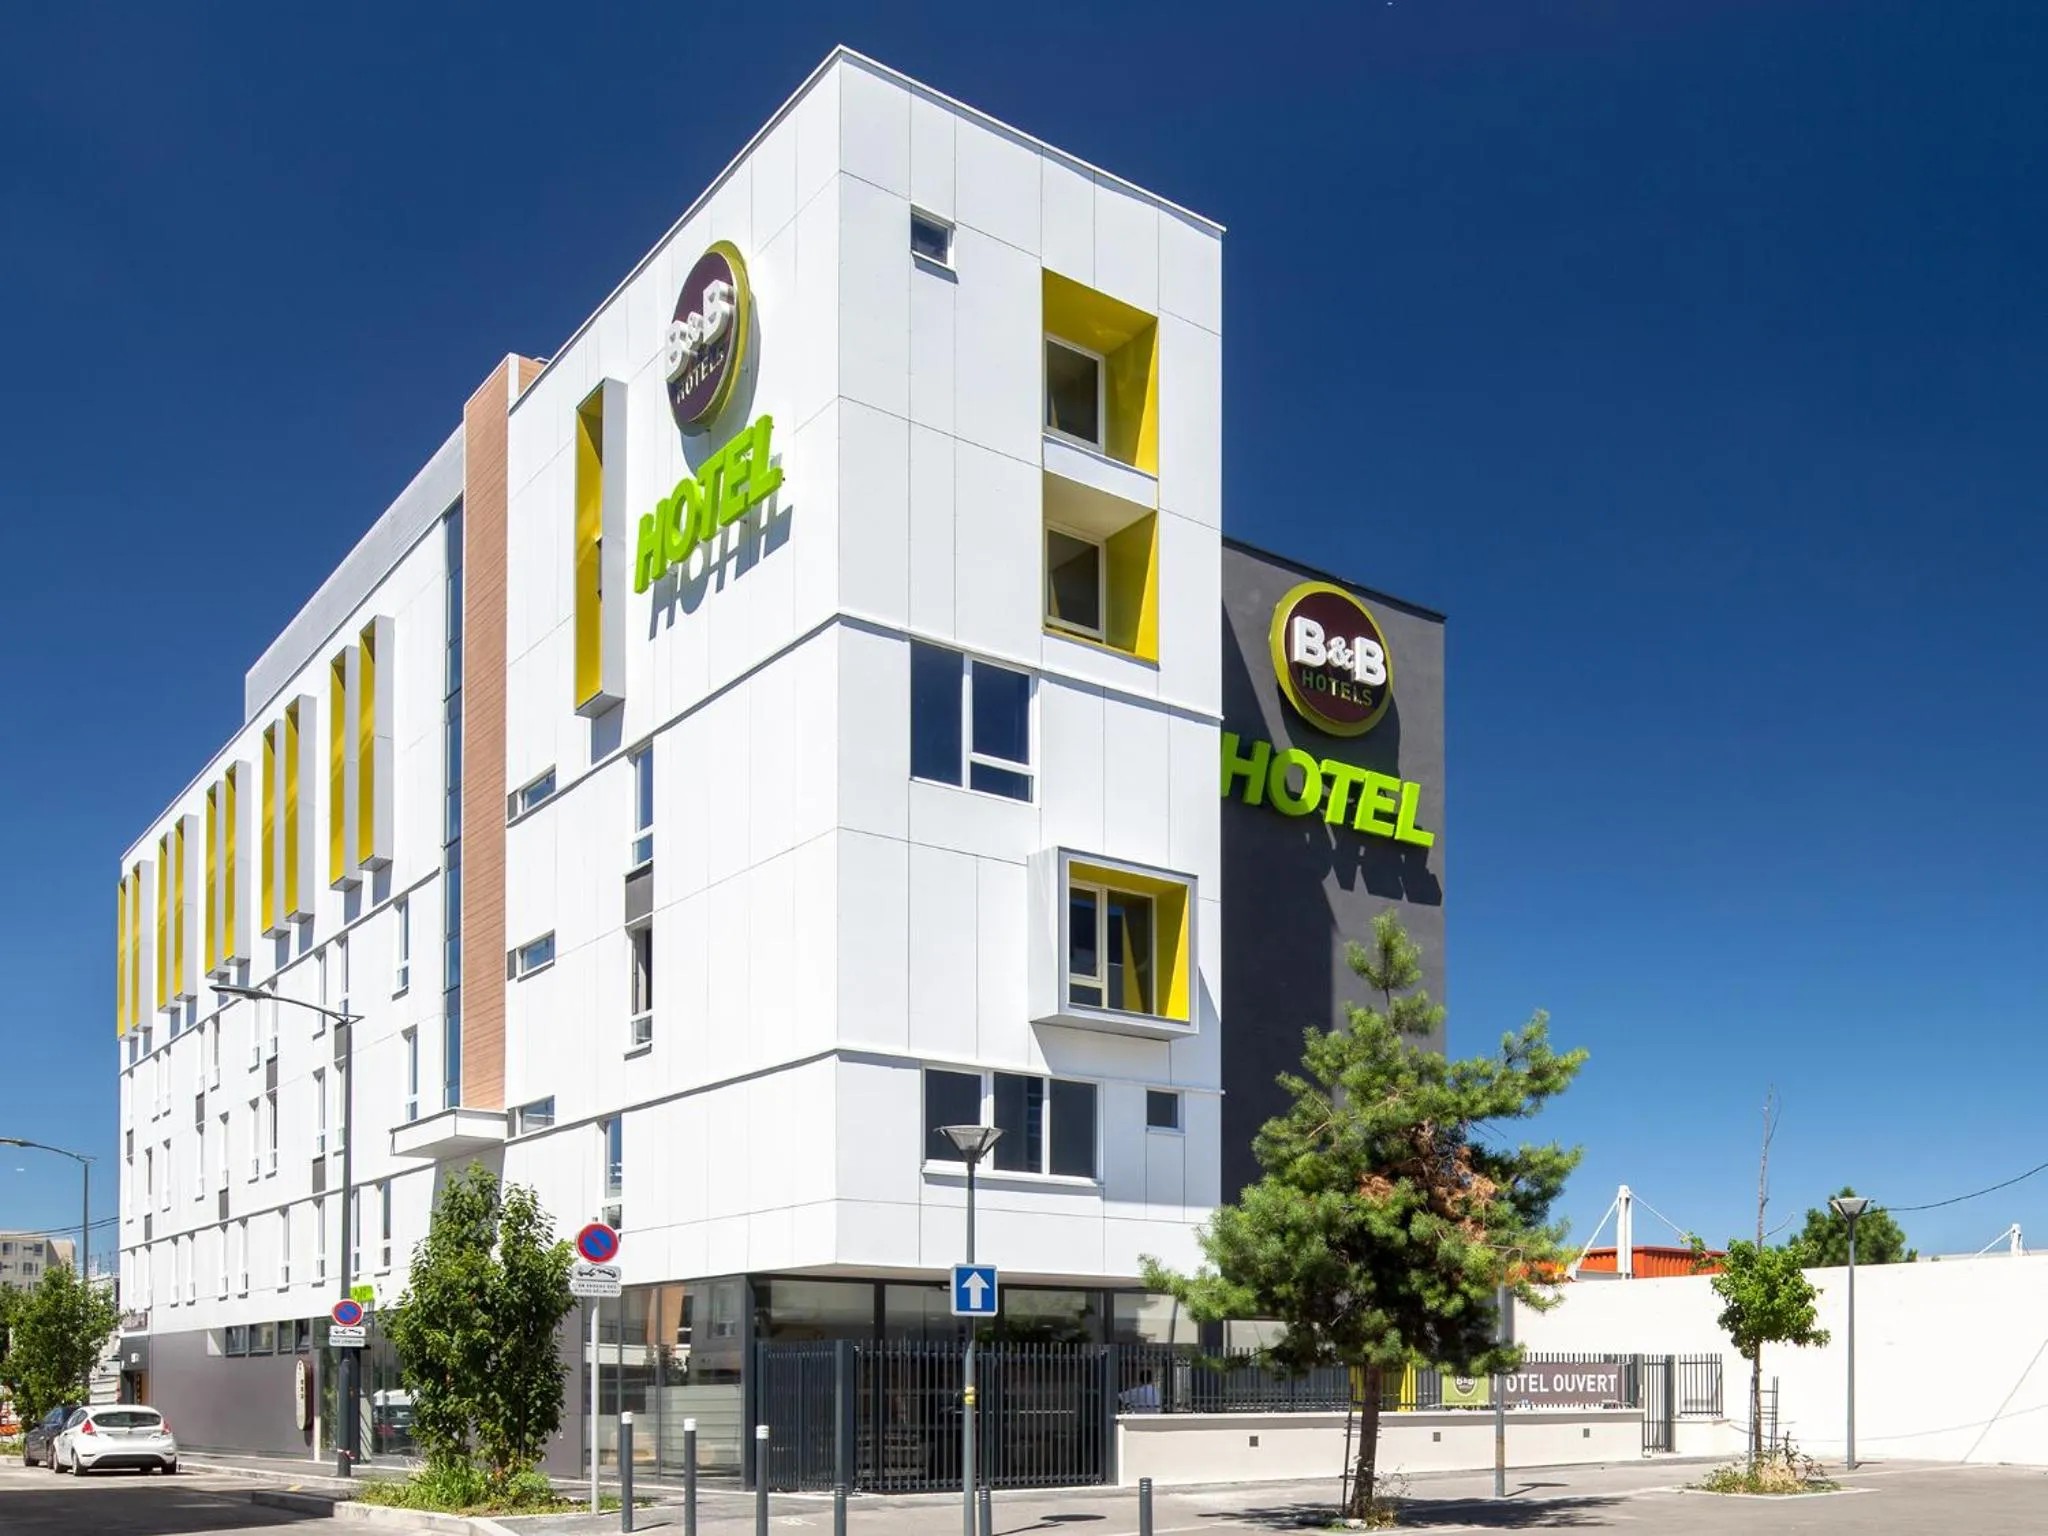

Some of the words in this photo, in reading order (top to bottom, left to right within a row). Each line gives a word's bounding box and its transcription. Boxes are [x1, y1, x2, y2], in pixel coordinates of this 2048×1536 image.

[665, 279, 733, 382] B&B
[634, 414, 783, 595] HOTEL
[1291, 616, 1387, 687] B&B
[1302, 669, 1373, 706] HOTELS
[1221, 731, 1435, 848] HOTEL
[1553, 1373, 1617, 1393] OUVERT
